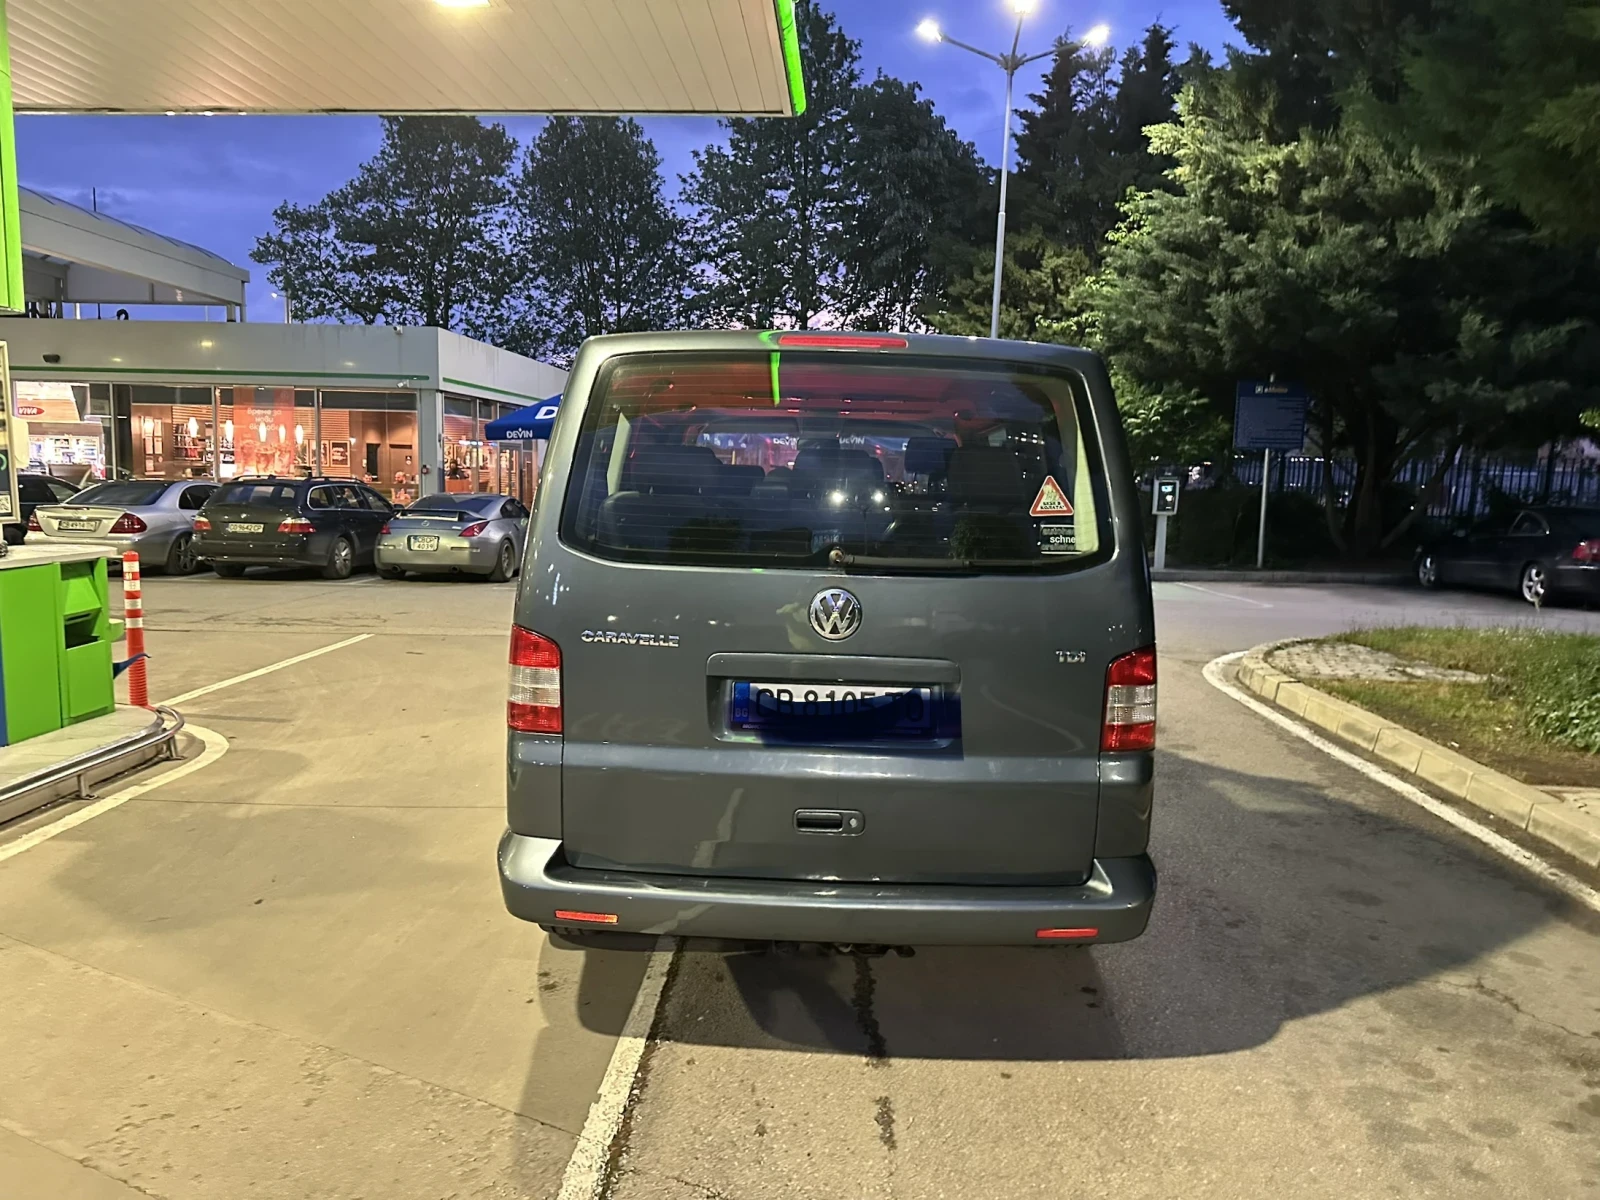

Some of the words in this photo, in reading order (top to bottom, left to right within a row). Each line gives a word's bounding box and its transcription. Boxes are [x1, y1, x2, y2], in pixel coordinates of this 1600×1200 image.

[506, 428, 533, 439] DEVIN
[580, 629, 680, 648] CARAVELLE
[734, 707, 749, 718] BG
